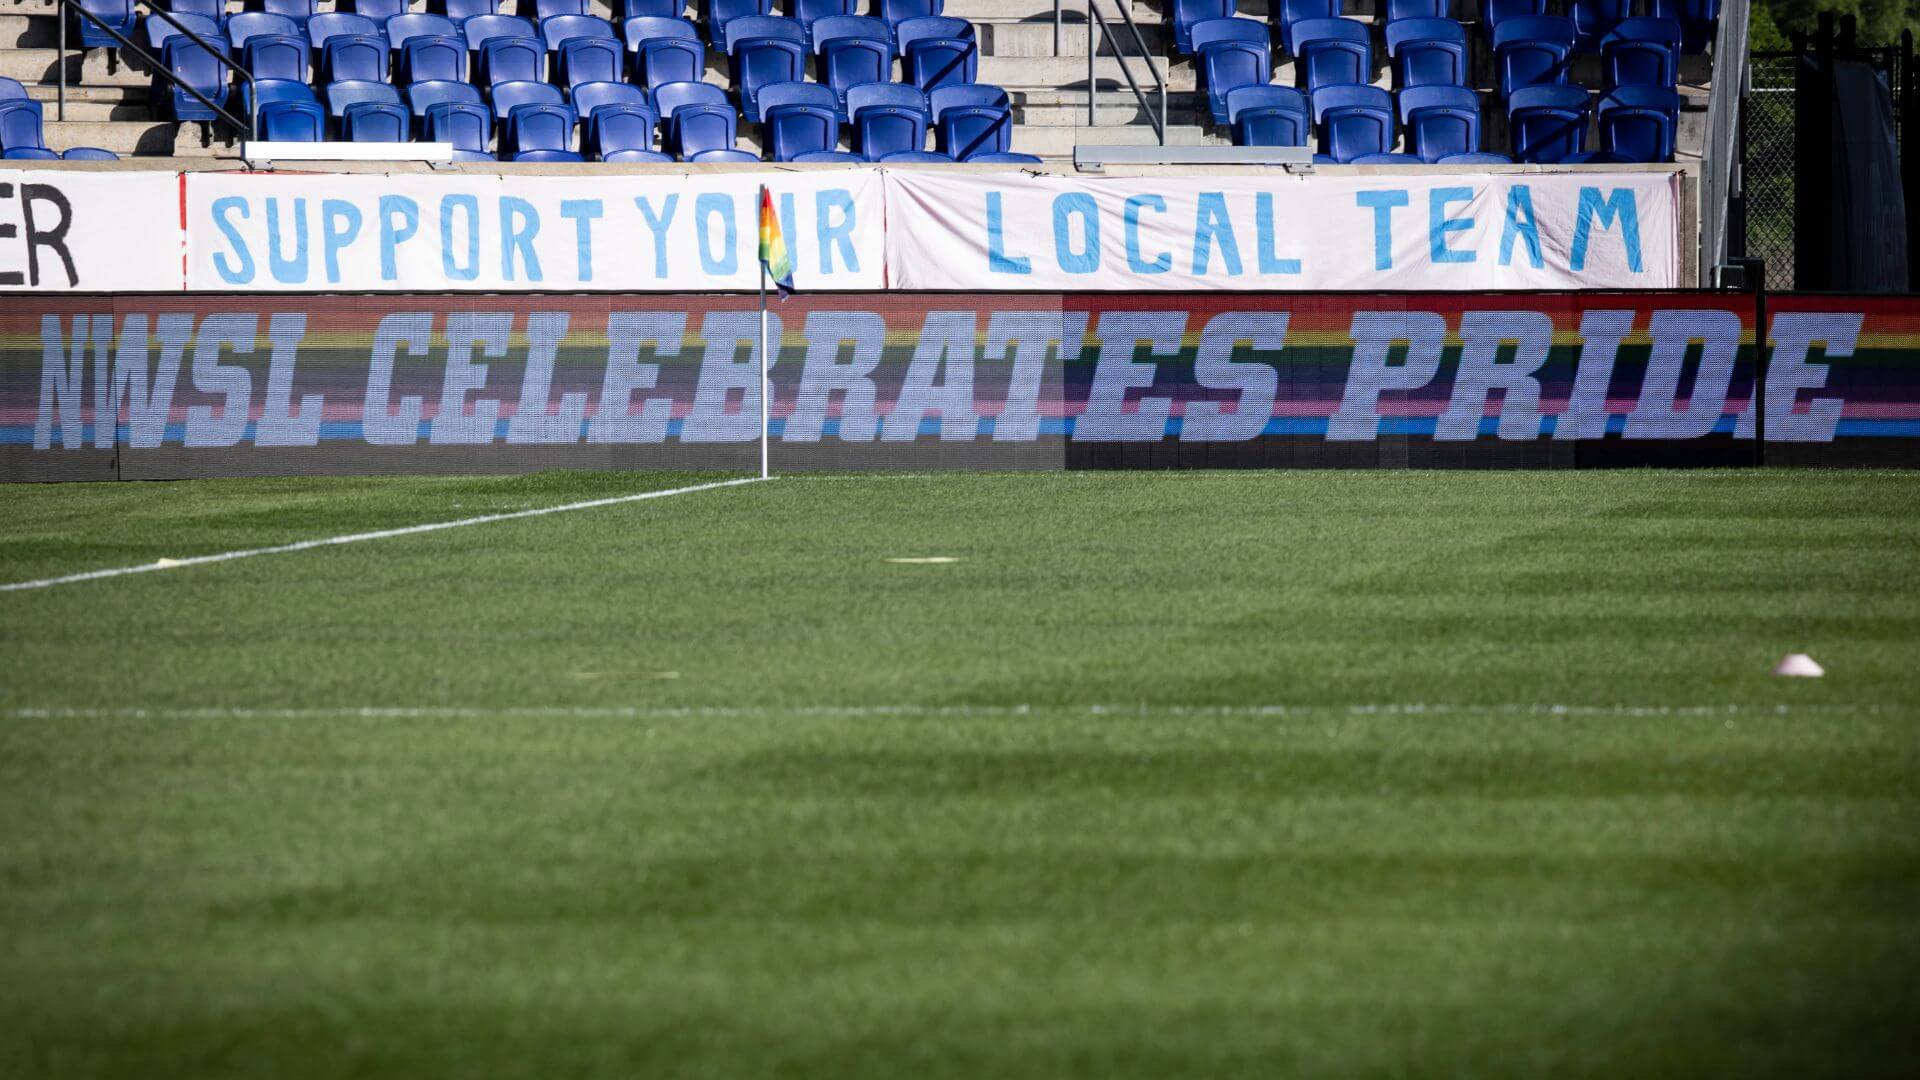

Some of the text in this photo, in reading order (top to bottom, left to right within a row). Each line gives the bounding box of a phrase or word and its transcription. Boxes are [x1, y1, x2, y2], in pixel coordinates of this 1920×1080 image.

[211, 194, 603, 284] SUPPORT
[985, 191, 1302, 276] LOCAL
[1356, 184, 1644, 273] TEAM
[33, 309, 1865, 450] NWSL CELEBRATES PRIDE
